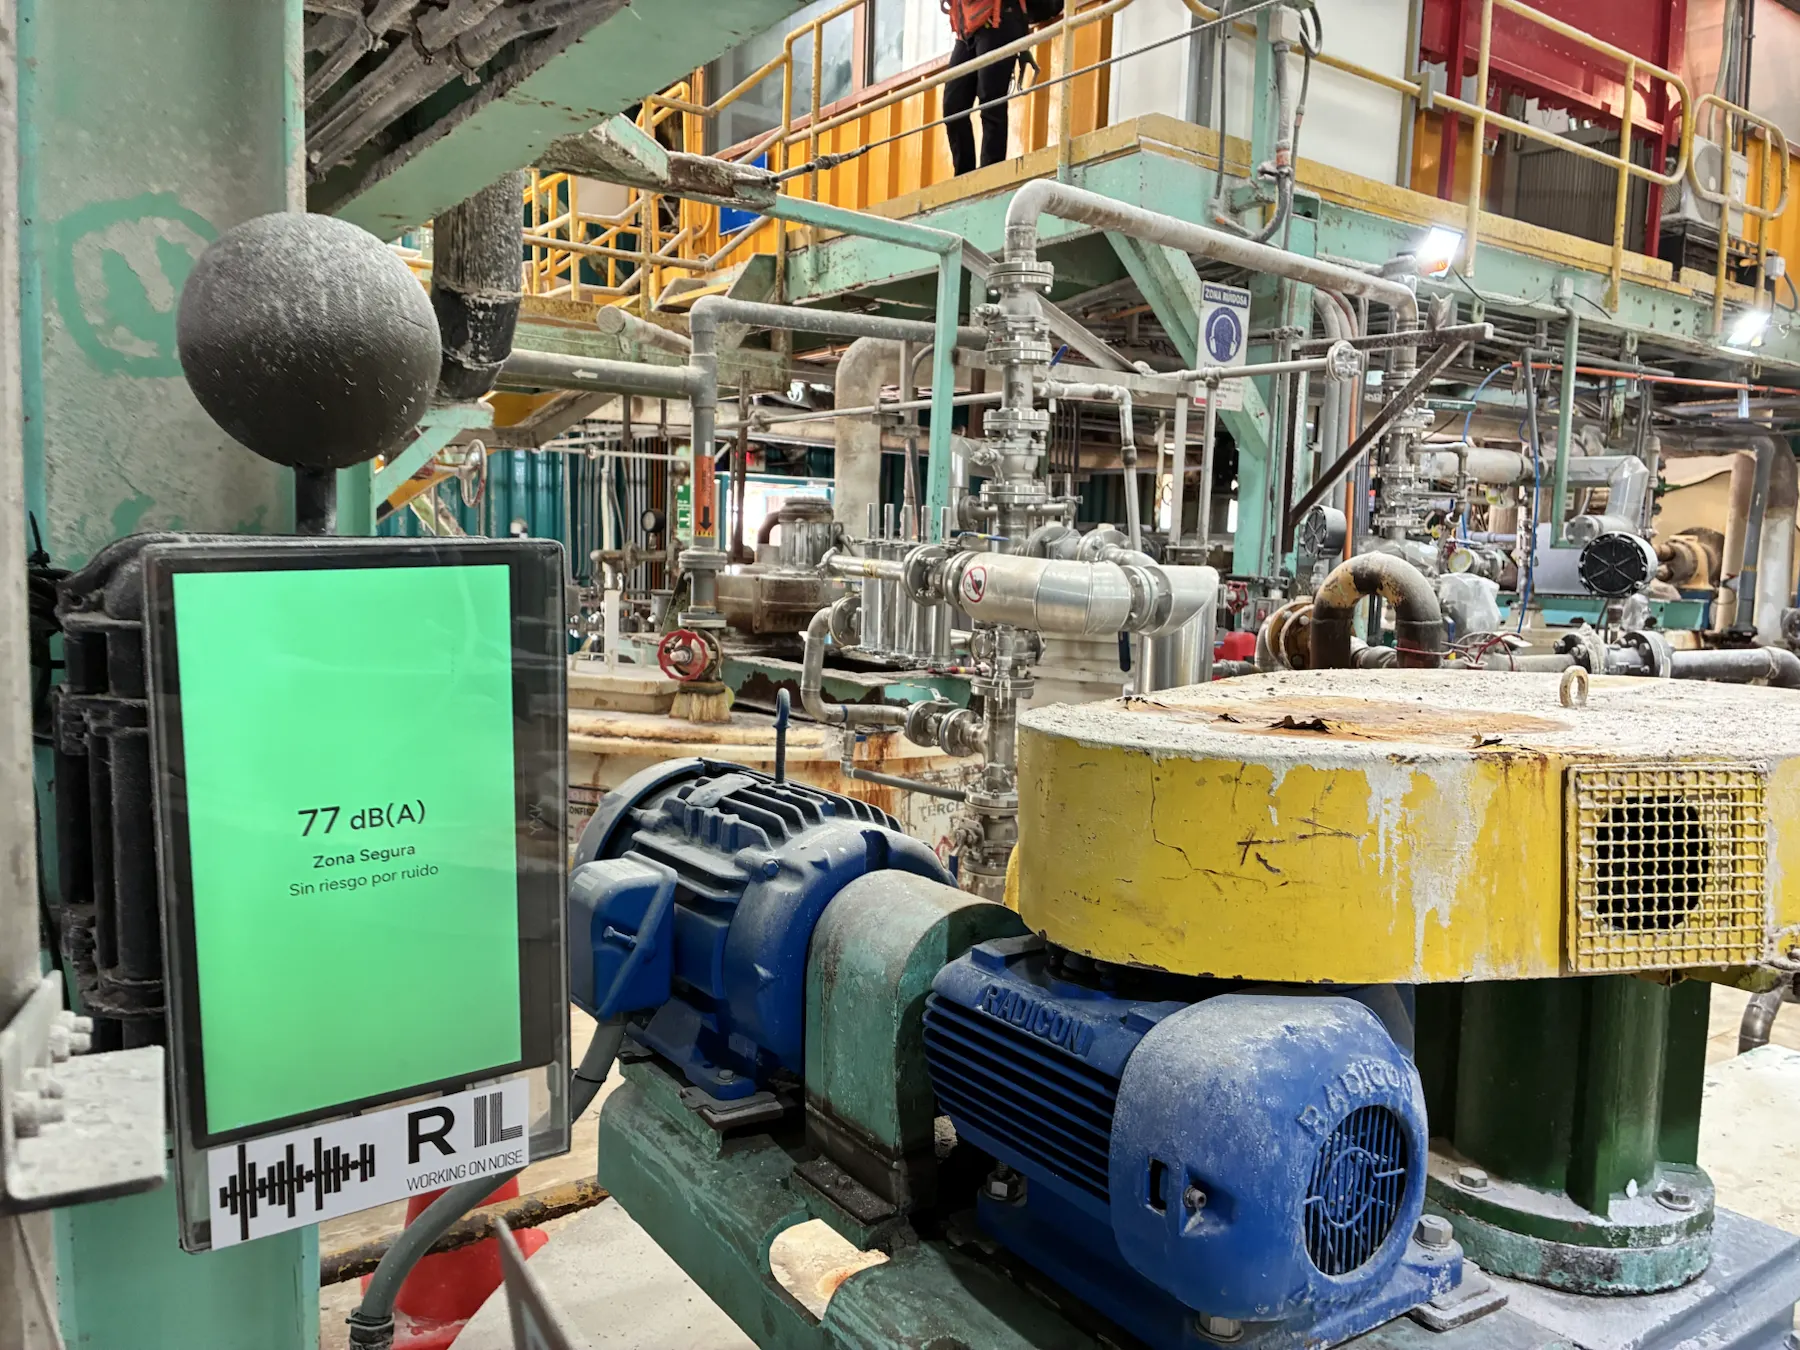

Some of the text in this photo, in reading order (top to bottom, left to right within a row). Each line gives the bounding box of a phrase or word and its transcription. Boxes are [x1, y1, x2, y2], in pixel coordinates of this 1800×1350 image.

[1205, 288, 1248, 305] ZONA RUIDOSA
[297, 799, 426, 837] 77 dB(A)
[312, 845, 416, 869] Zona Segura
[288, 863, 440, 897] Sin riesgo por ruido
[982, 985, 1089, 1057] RADICON
[1297, 1057, 1412, 1135] RADICON
[406, 1150, 523, 1191] WORKING ON NOISE
